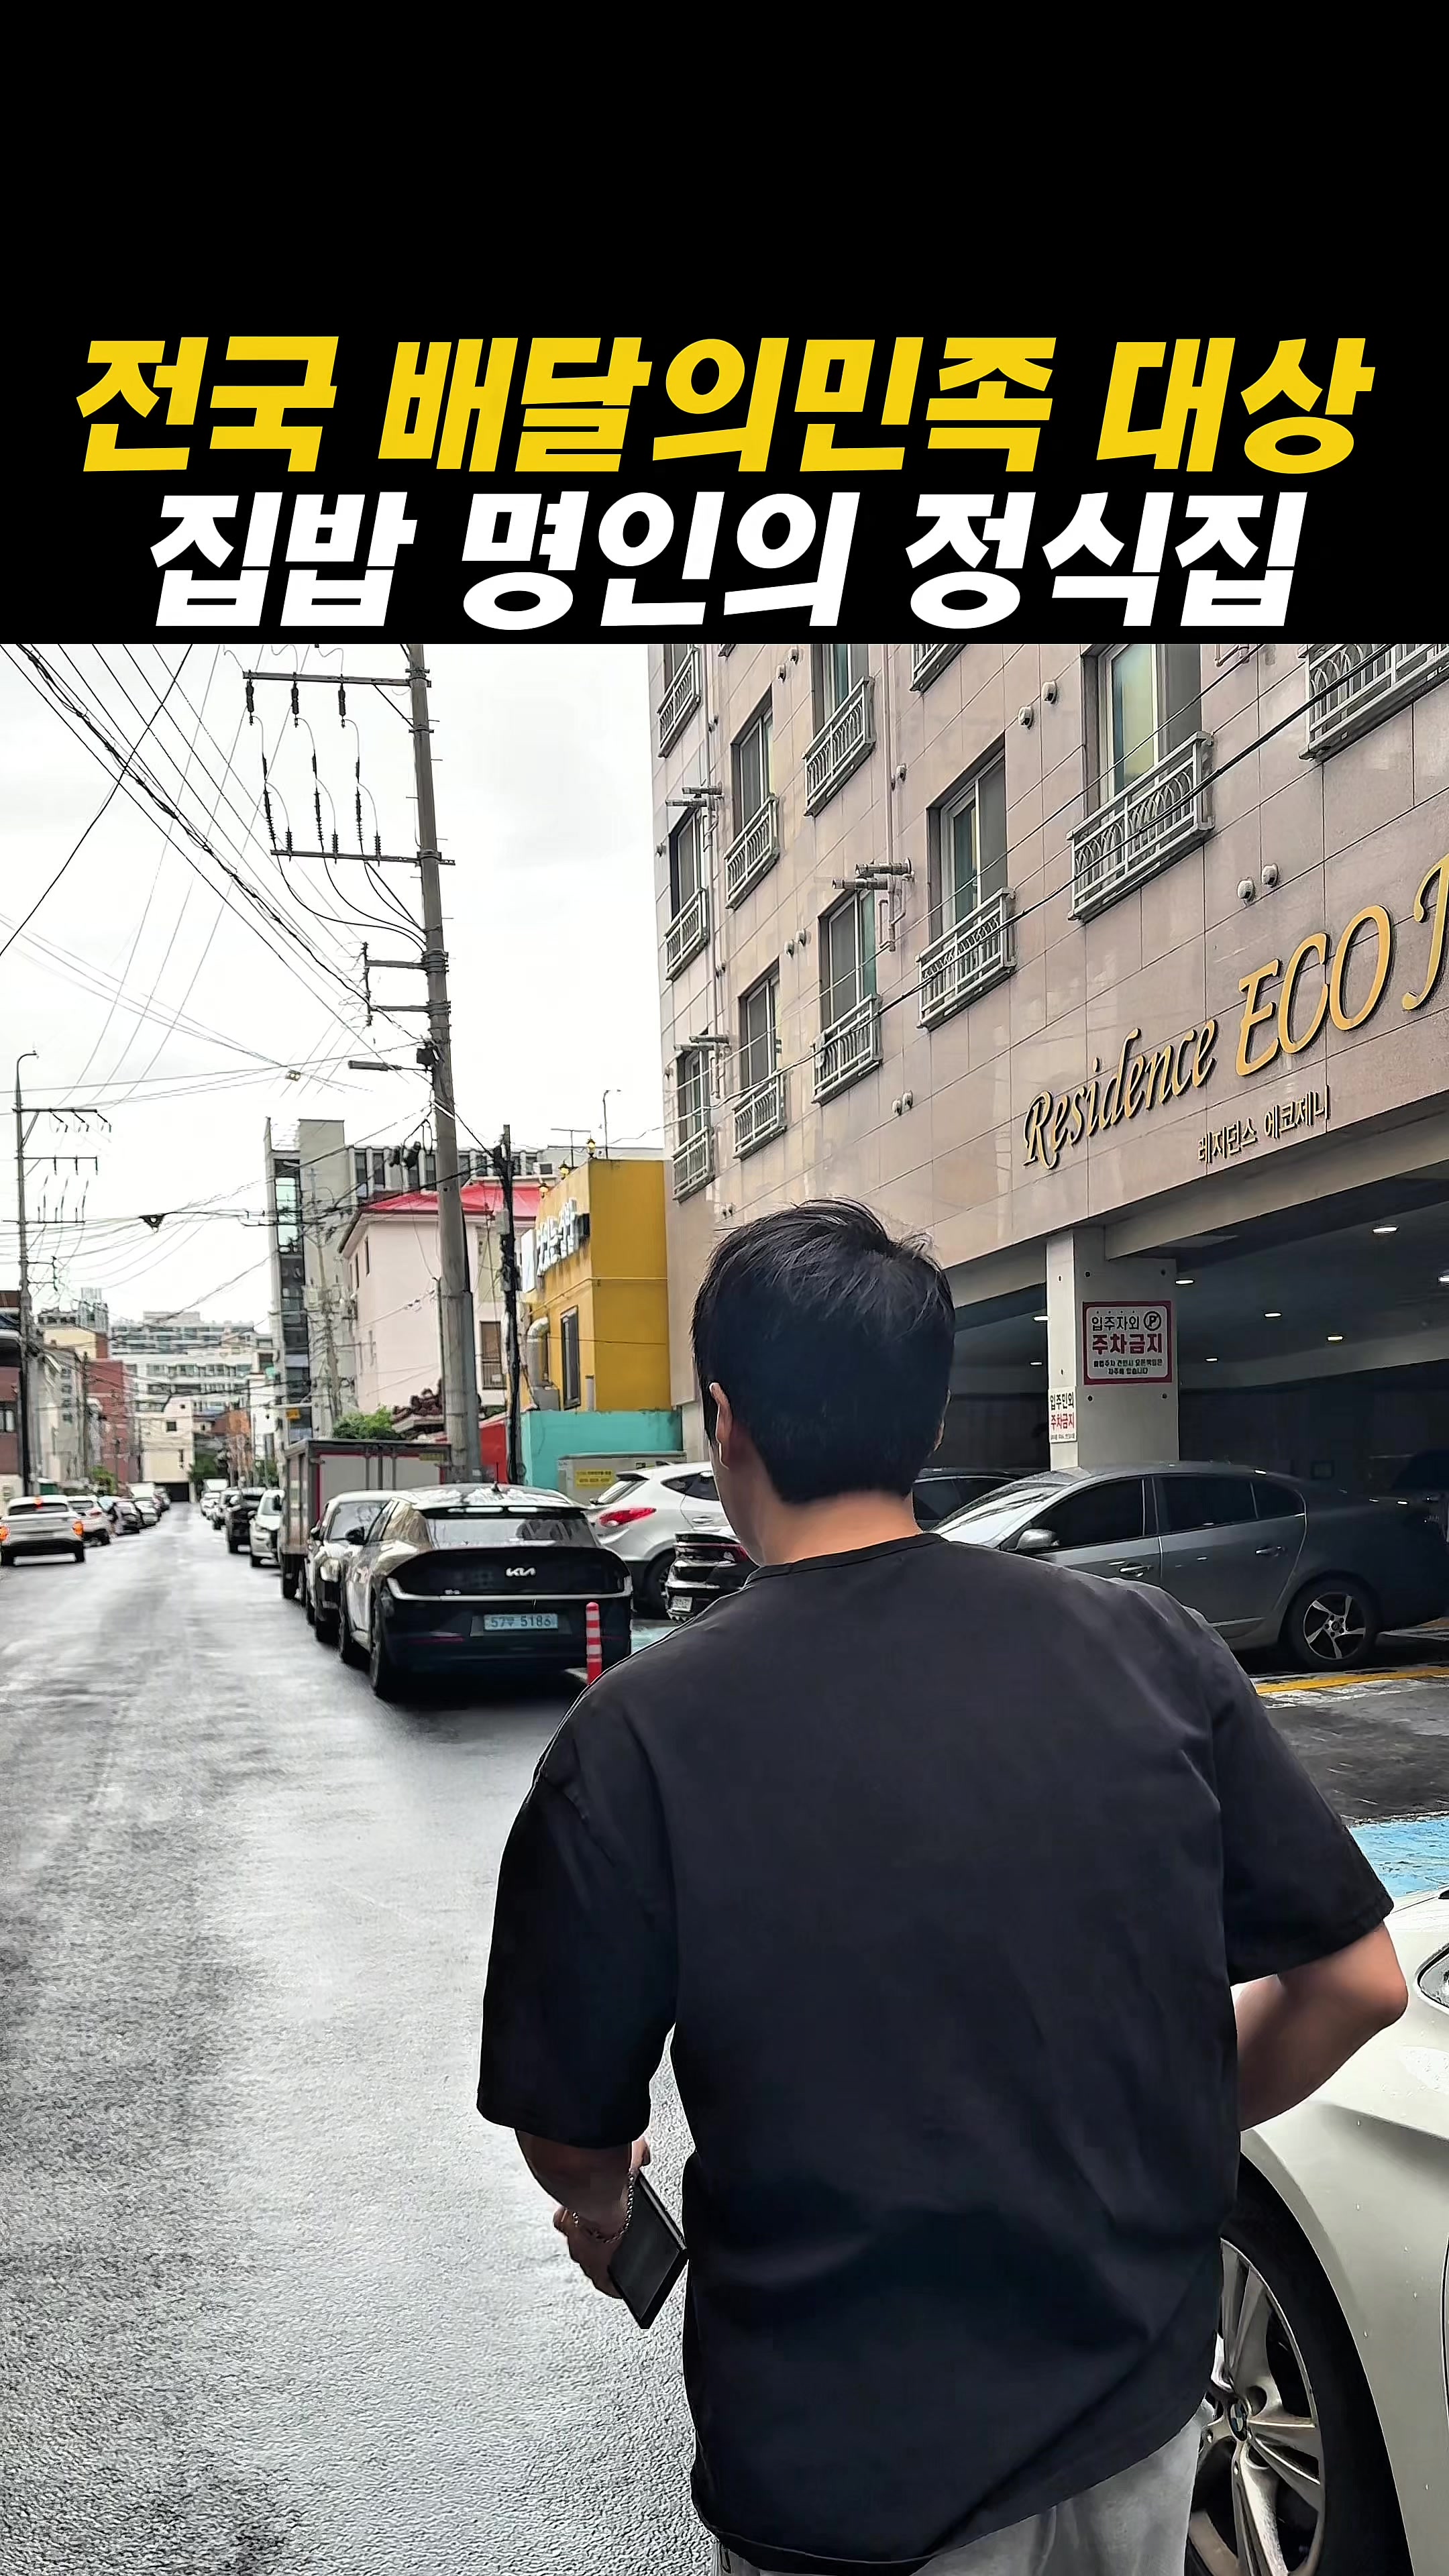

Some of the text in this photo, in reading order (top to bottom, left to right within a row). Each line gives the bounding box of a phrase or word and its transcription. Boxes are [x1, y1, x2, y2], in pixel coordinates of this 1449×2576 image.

[1024, 1018, 1218, 1169] Residence
[1235, 904, 1393, 1077] ECO
[1197, 1084, 1329, 1164] 레지던스 에코제니
[1091, 1316, 1139, 1332] 입주자외
[1091, 1333, 1163, 1355] 주차금지
[1050, 1391, 1074, 1411] 입주민외
[1051, 1412, 1075, 1430] 주차금지
